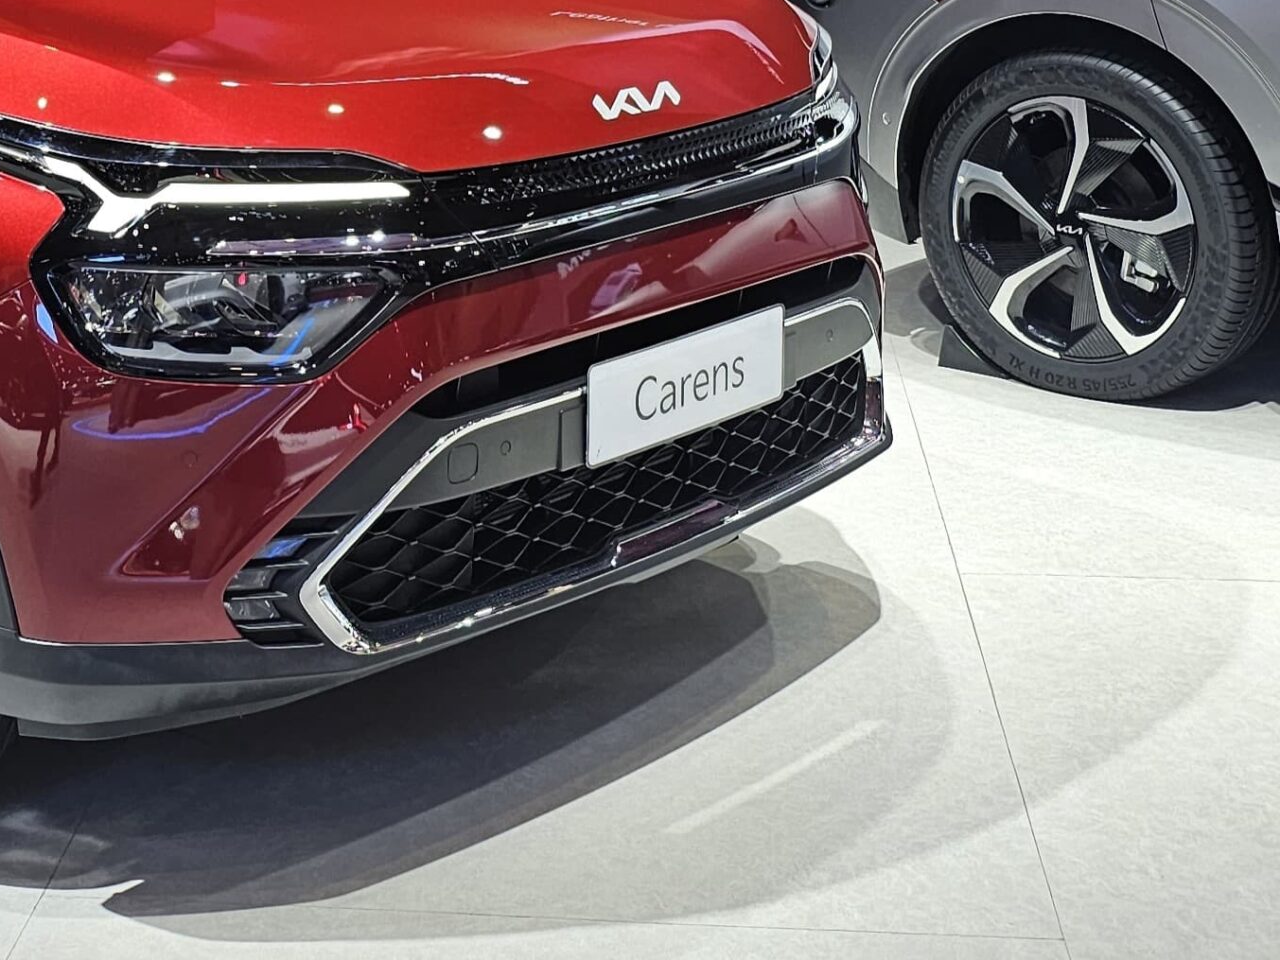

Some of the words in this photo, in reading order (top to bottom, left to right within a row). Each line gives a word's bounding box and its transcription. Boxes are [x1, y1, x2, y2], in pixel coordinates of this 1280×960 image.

[592, 80, 681, 121] KIA
[1057, 224, 1083, 235] KIA
[635, 356, 745, 421] Carens
[1082, 373, 1137, 392] 255/45
